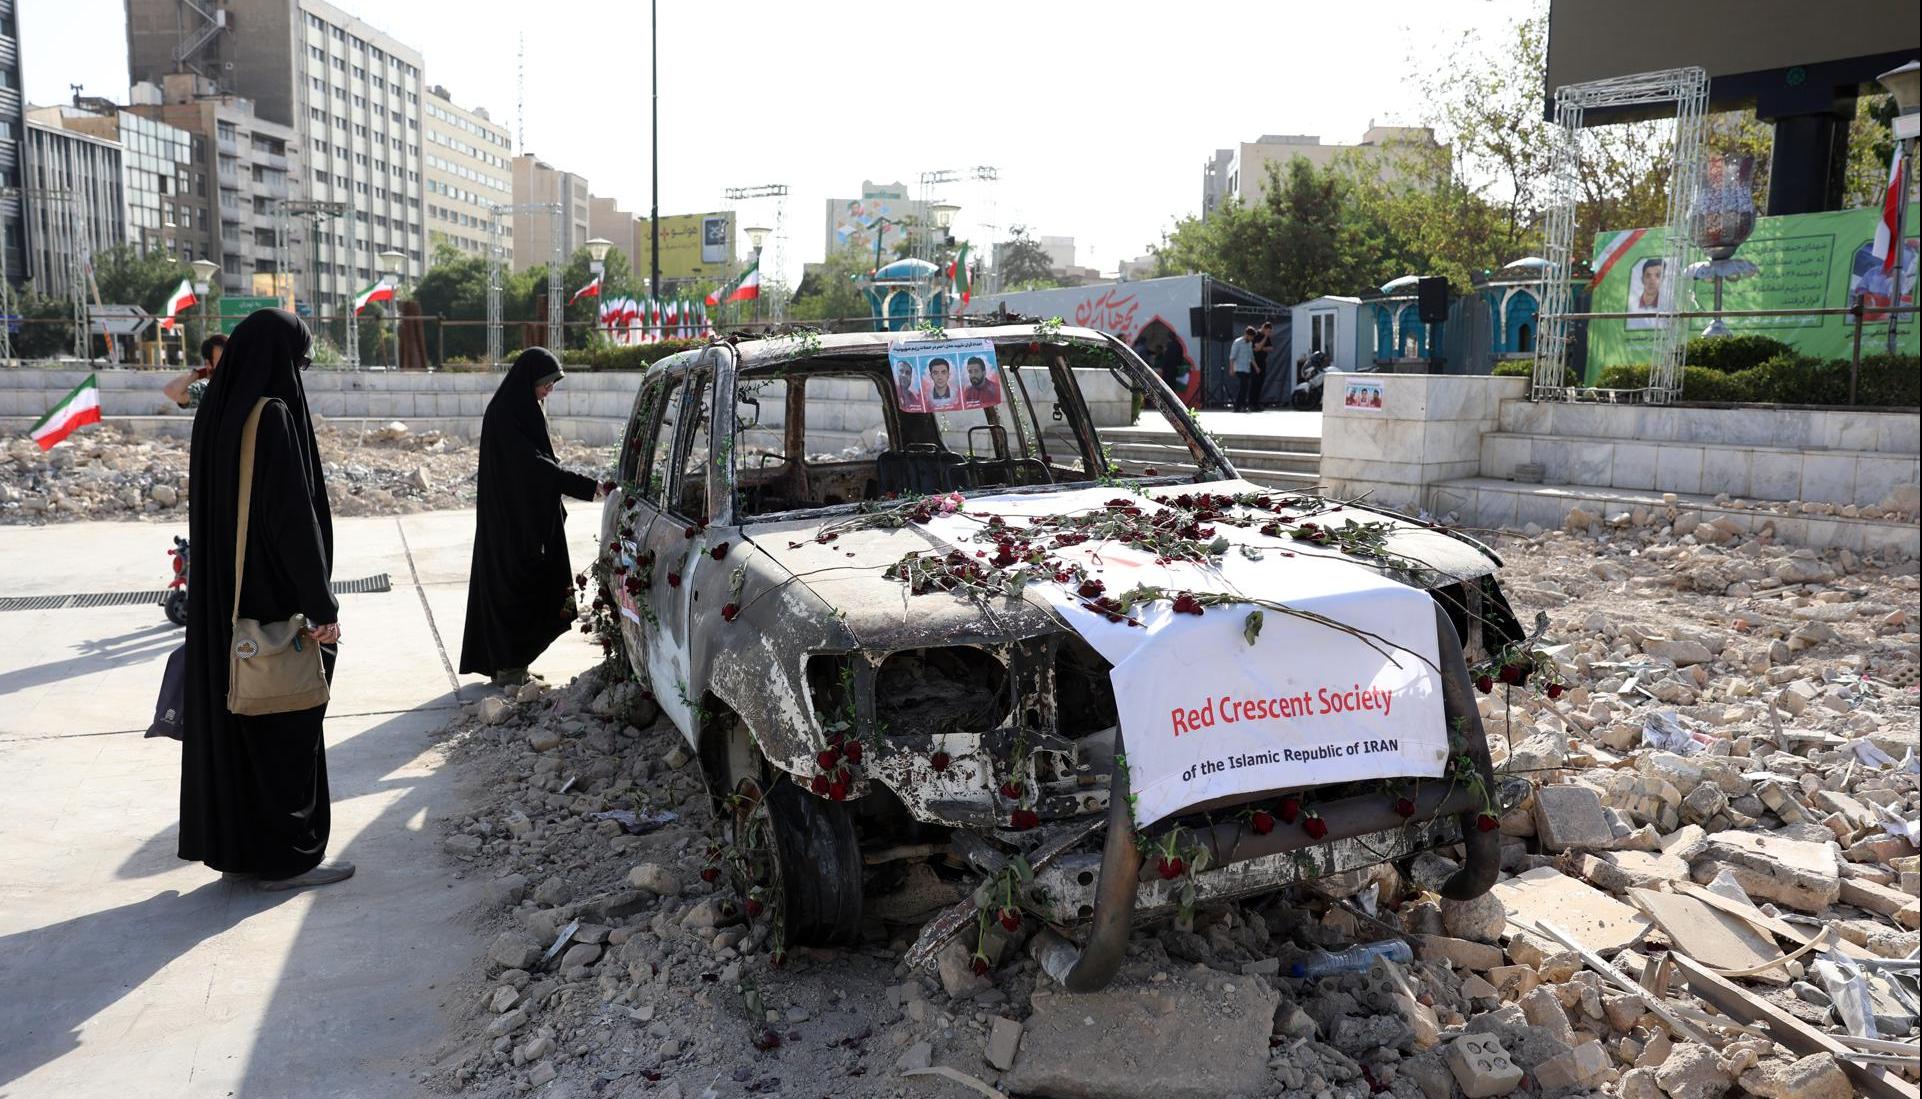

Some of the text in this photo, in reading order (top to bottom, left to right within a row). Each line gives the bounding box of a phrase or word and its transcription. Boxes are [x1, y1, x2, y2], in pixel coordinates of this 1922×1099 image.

[1171, 684, 1393, 736] Red Crescent Society
[1182, 739, 1399, 782] of the Islamic Republic of IRAN
